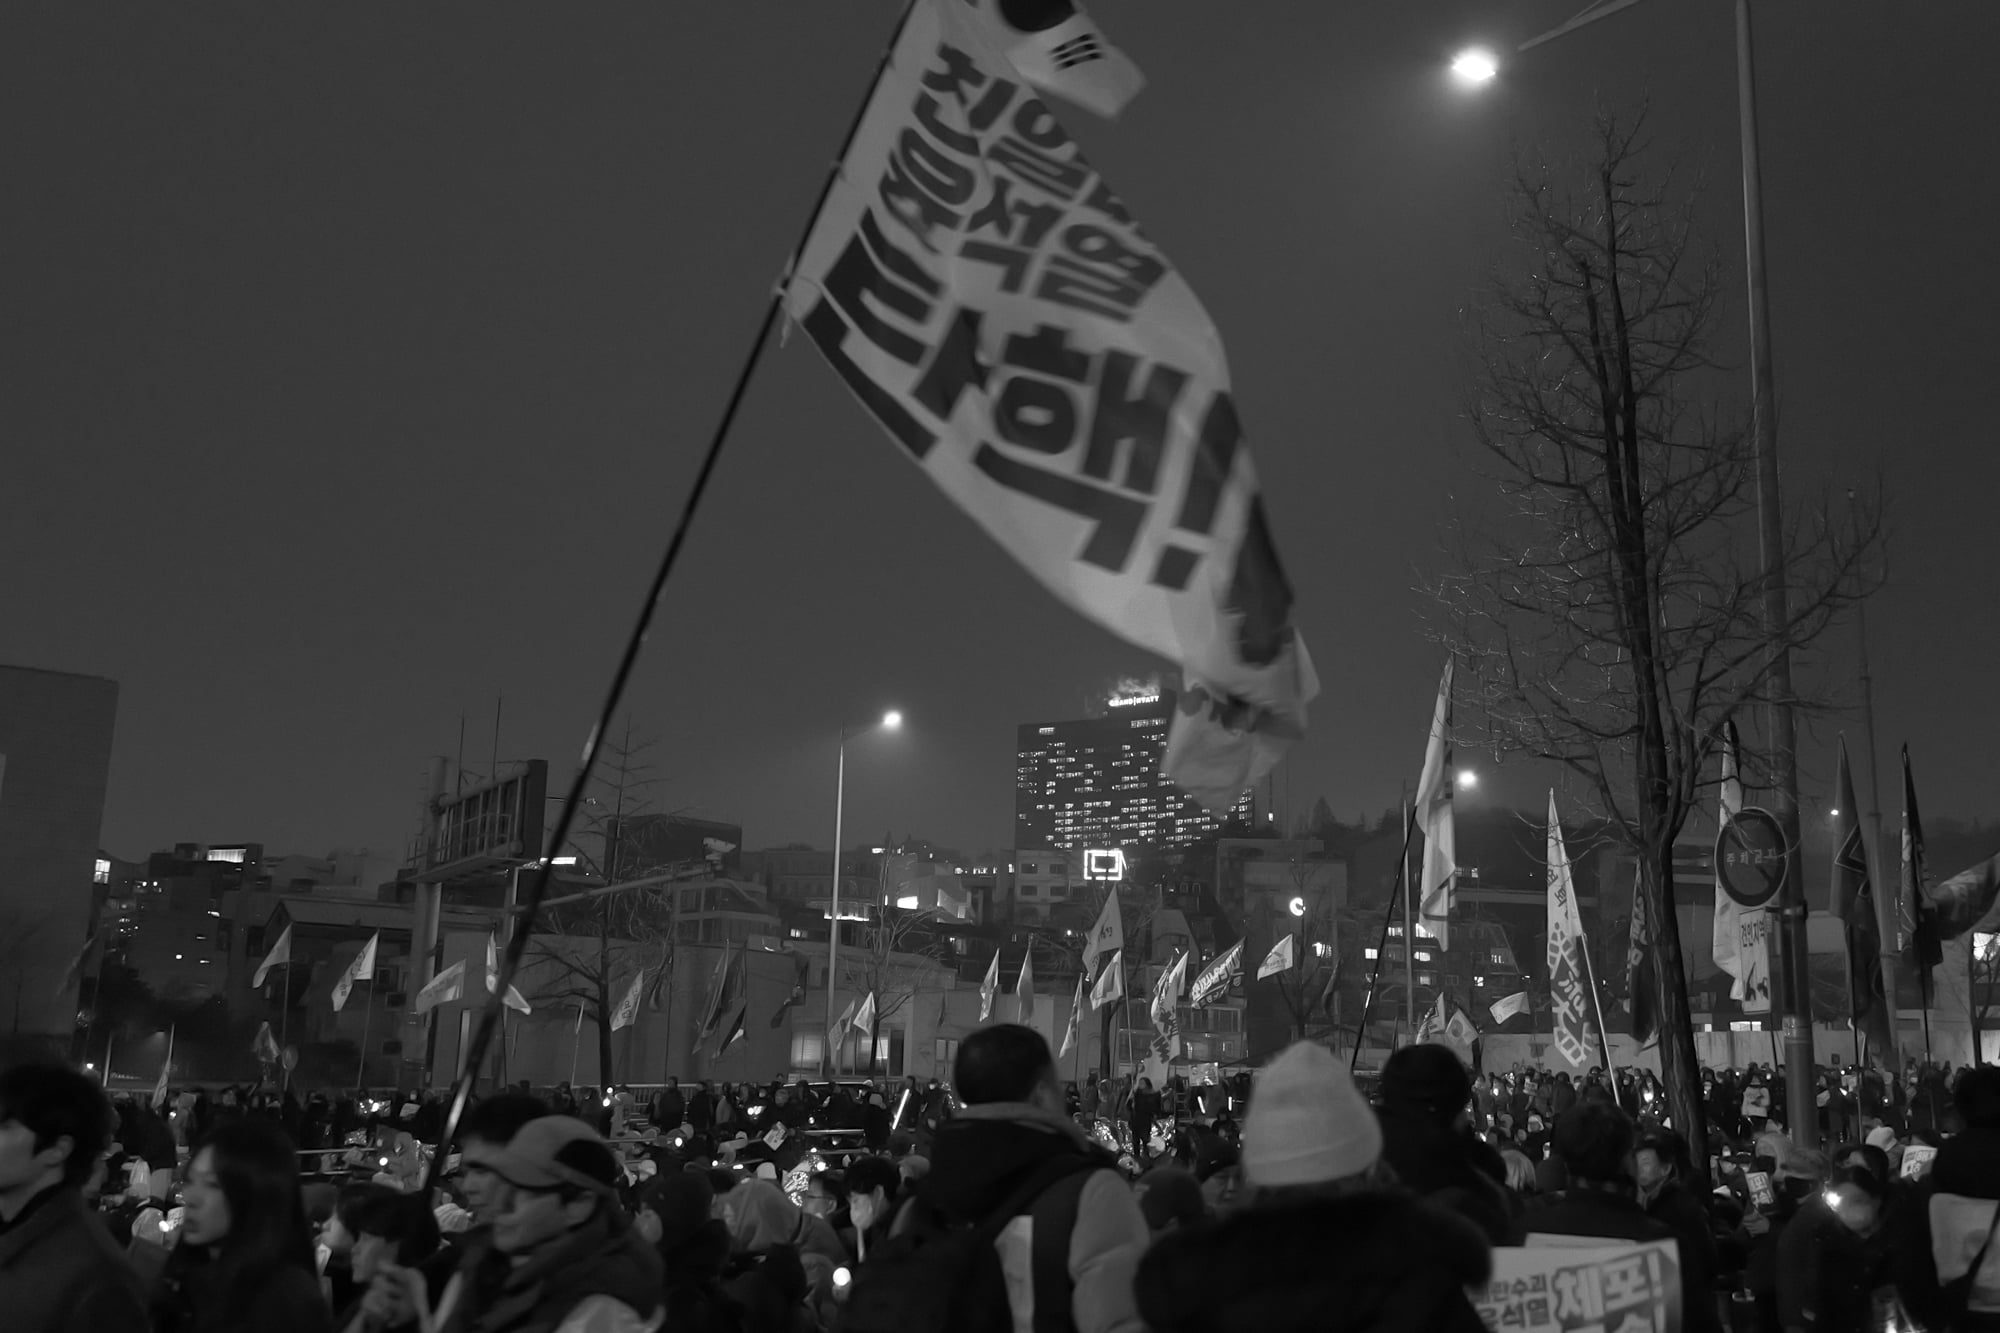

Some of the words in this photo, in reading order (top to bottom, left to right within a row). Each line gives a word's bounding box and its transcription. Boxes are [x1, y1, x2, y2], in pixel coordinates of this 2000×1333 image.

[879, 127, 1168, 323] 윤석열
[801, 206, 1243, 591] 탄핵!
[1741, 919, 1765, 948] 견인지역
